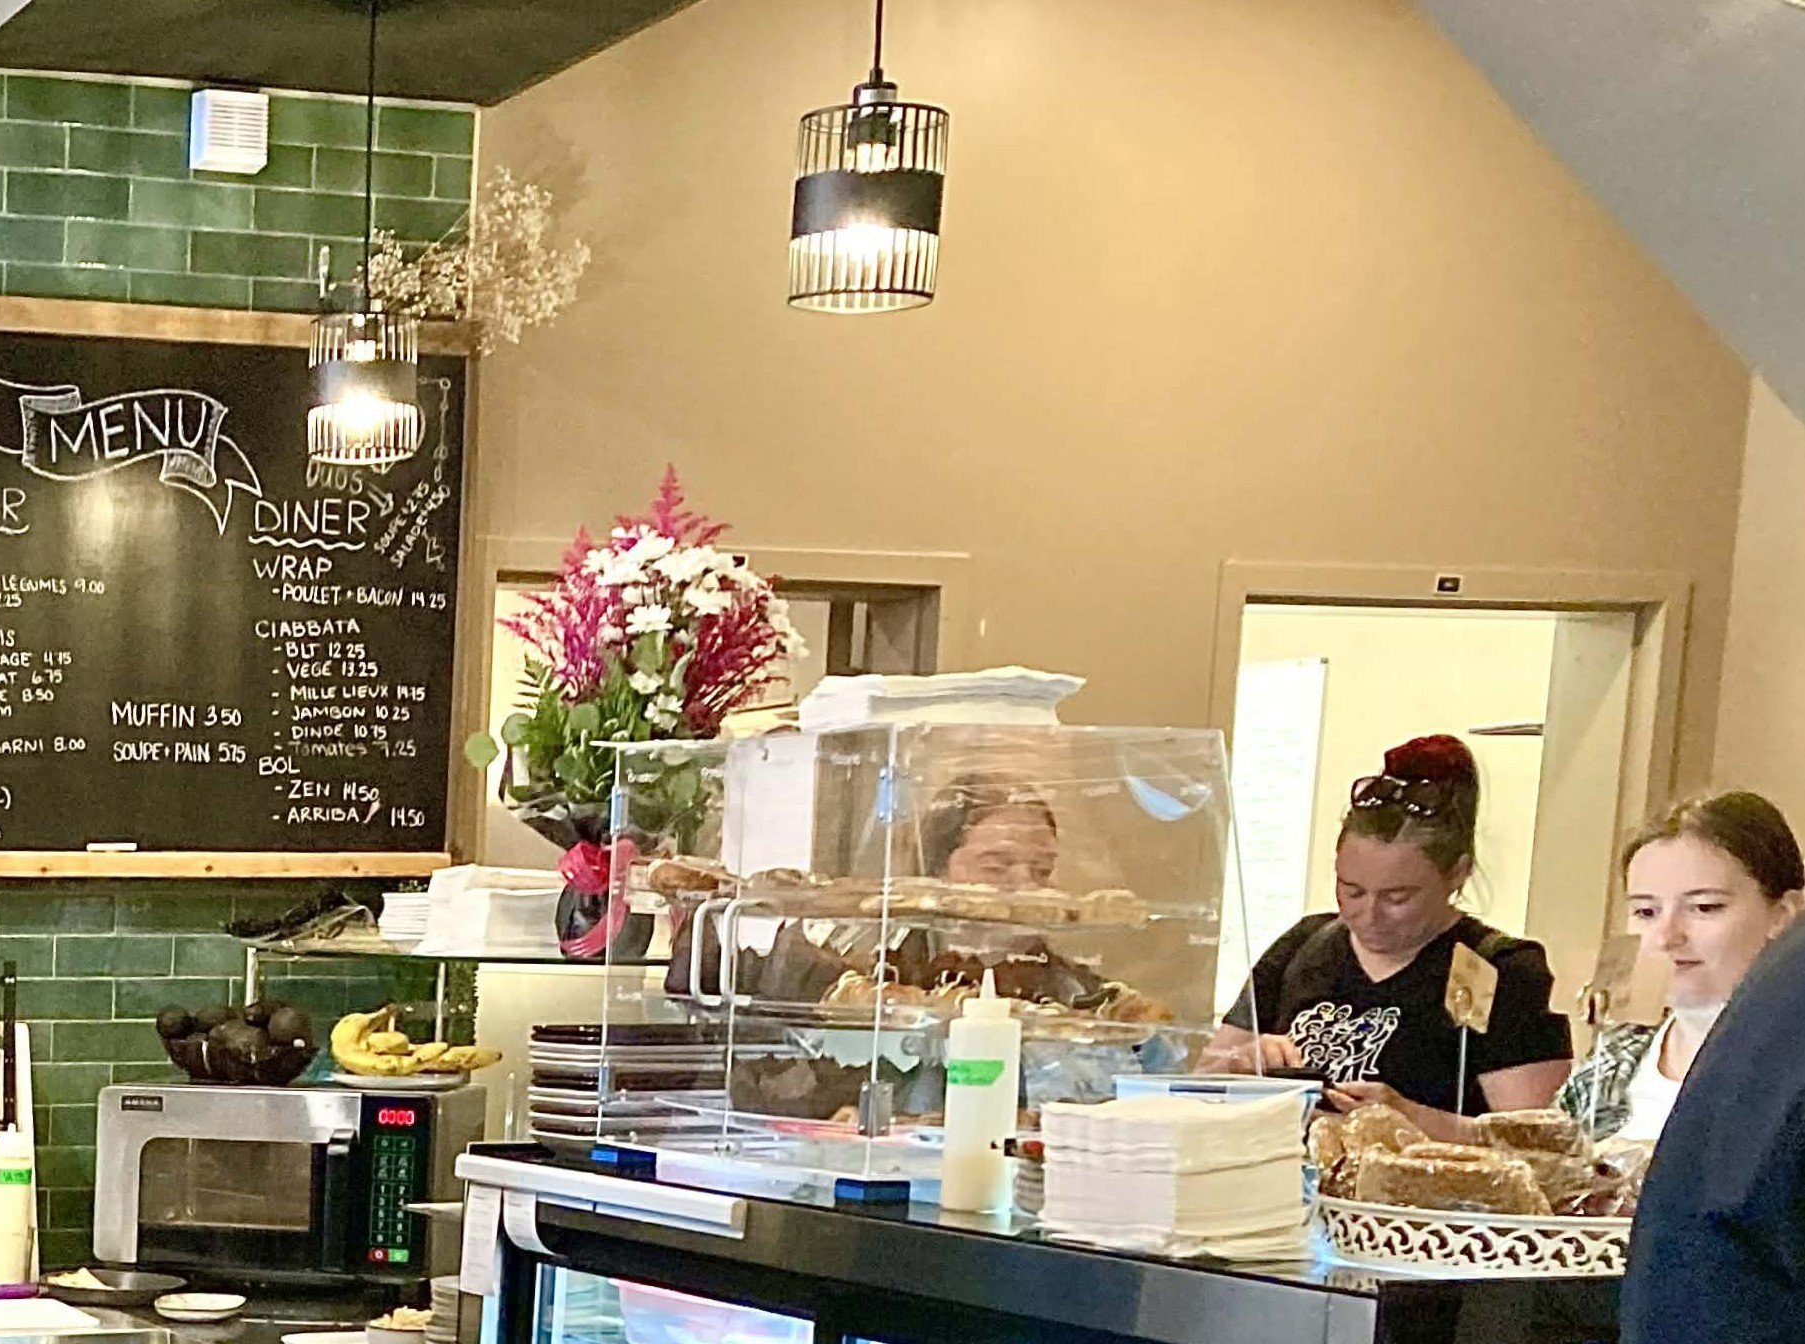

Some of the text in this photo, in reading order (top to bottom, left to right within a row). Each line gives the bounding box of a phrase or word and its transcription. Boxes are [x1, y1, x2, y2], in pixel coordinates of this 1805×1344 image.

[50, 397, 208, 464] MENU
[255, 498, 371, 535] DINER
[253, 554, 333, 580] WRAP
[282, 583, 341, 606] POULET
[357, 586, 403, 607] BACON
[255, 618, 361, 638] CIABBATA
[285, 641, 321, 659] BLT
[290, 685, 337, 701] MILLE
[342, 685, 389, 699] LIEUX
[111, 700, 195, 728] MUFFIN
[291, 706, 366, 721] JAMBON
[291, 723, 344, 740] DINDE
[113, 740, 164, 762] SOUPE
[174, 741, 211, 763] PAIN
[259, 755, 301, 776] BOL
[287, 779, 330, 800] ZEN
[287, 806, 360, 825] ARRIBA
